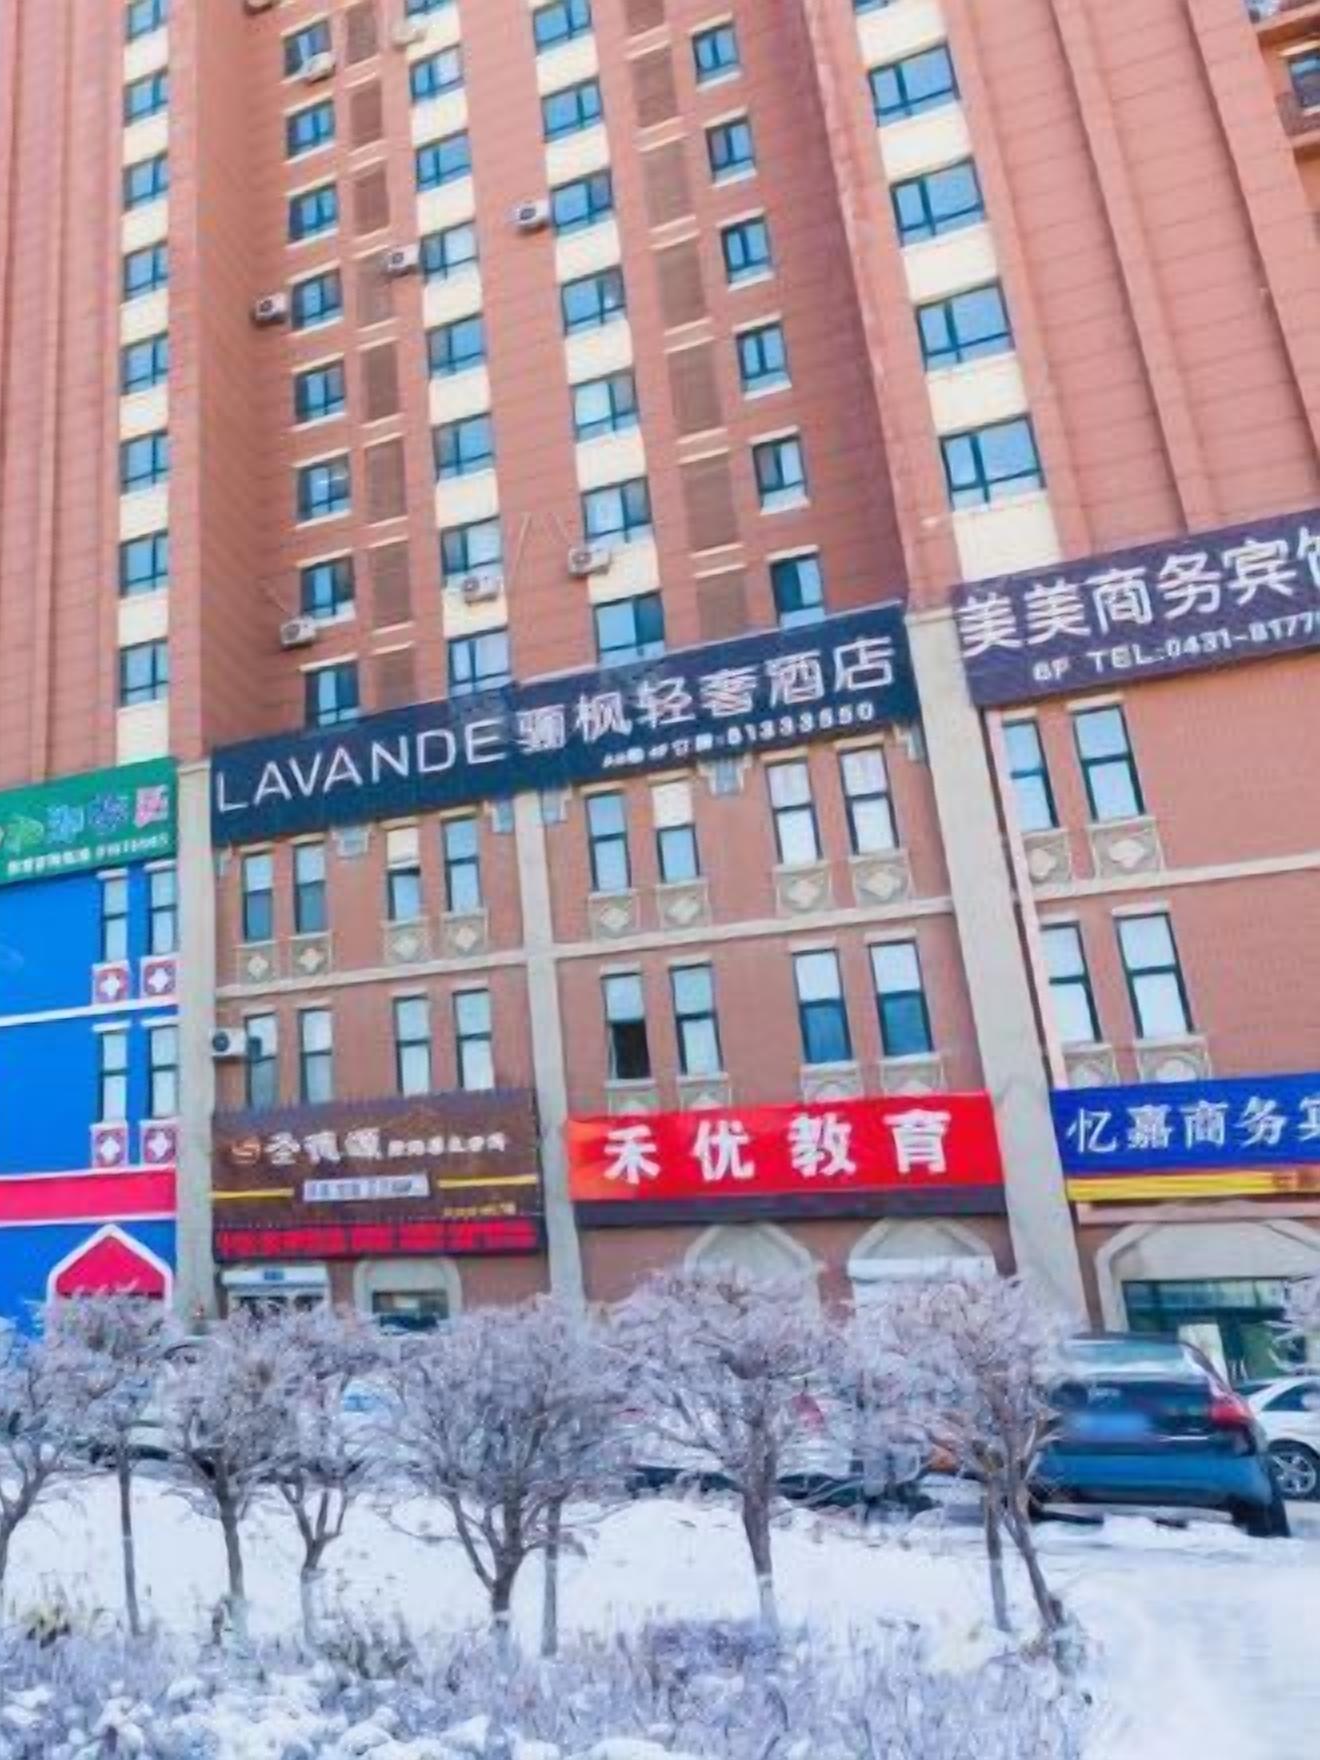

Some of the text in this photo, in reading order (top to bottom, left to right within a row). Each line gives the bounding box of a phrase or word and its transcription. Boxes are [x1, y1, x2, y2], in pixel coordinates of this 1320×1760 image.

[216, 717, 508, 813] LAVANDE
[604, 1109, 952, 1184] 禾优教育
